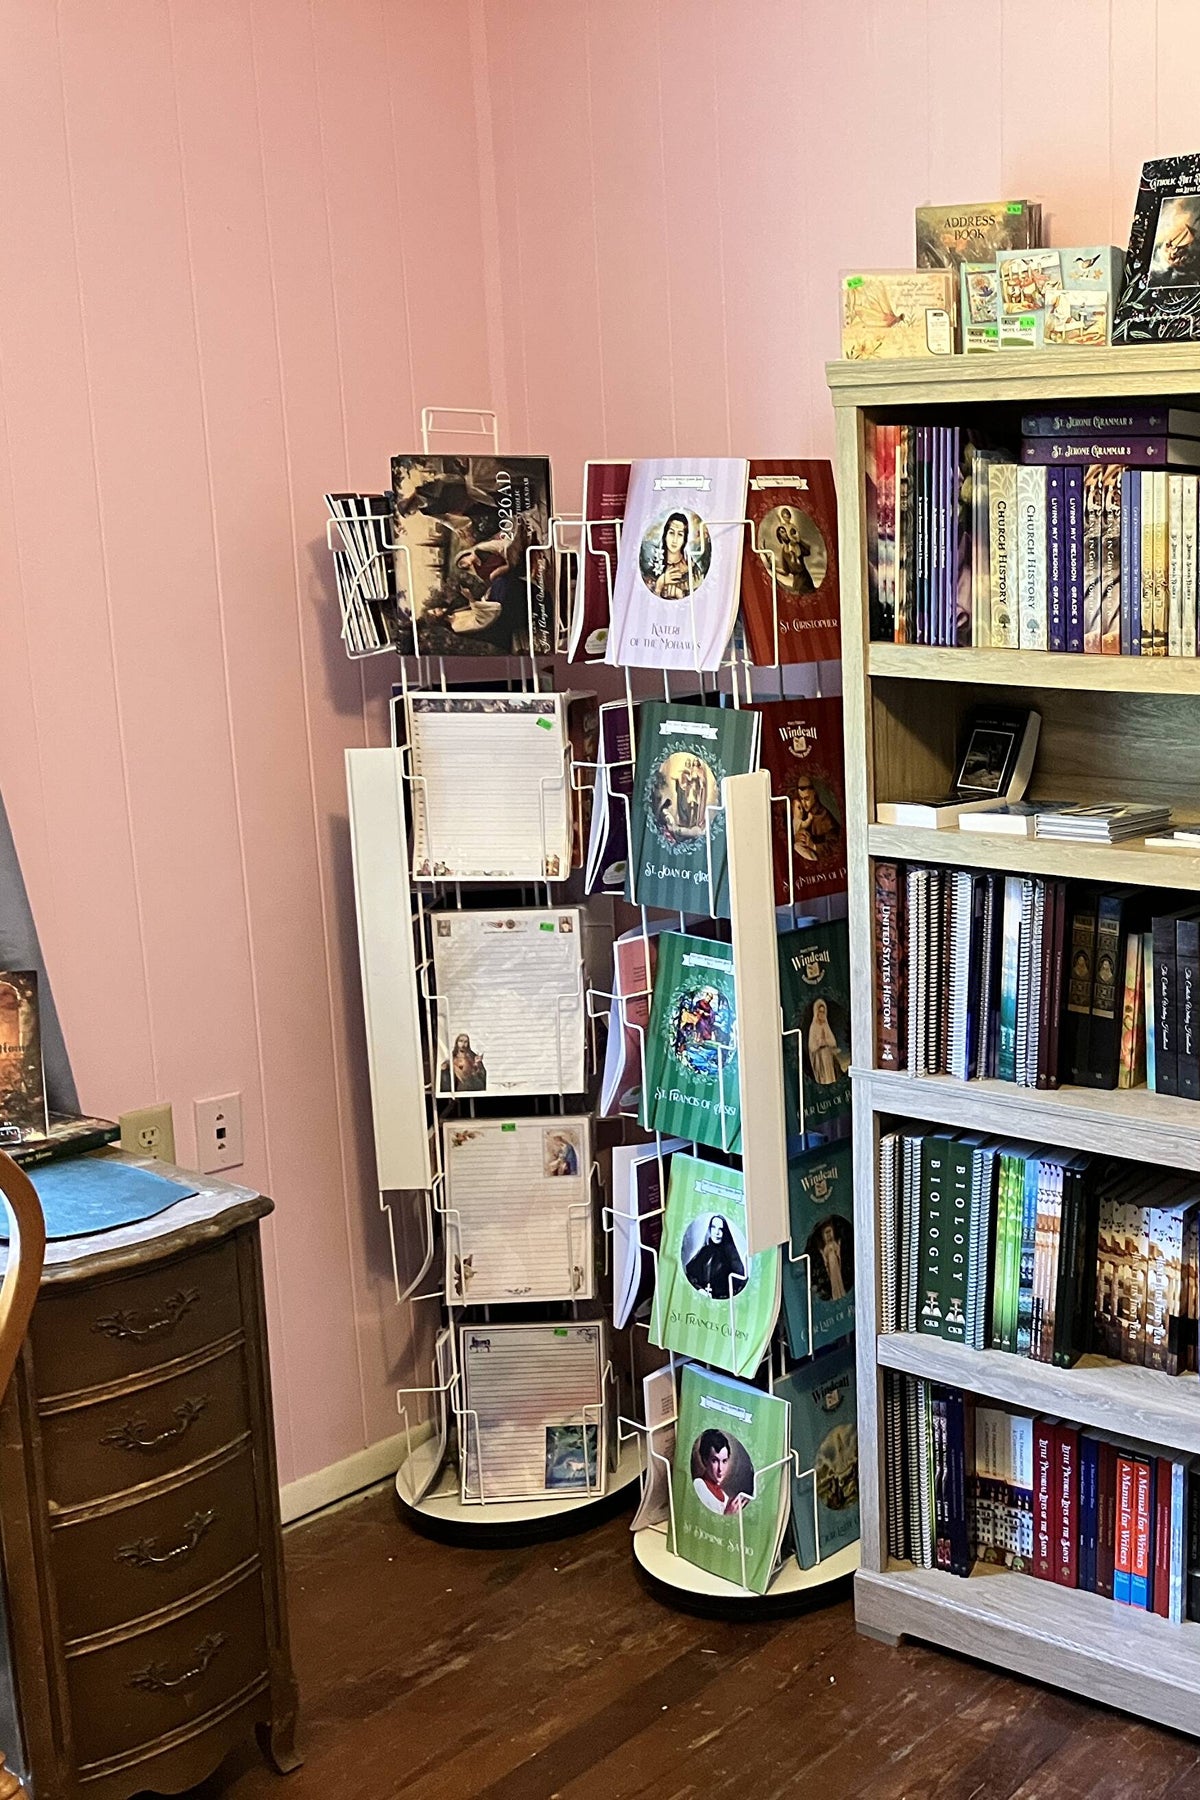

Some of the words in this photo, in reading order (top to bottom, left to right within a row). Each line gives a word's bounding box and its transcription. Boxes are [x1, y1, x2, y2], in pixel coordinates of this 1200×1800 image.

[1150, 178, 1176, 190] CATHOLIC
[1178, 174, 1193, 187] ART
[944, 215, 996, 228] ADDRESS
[954, 229, 986, 241] BOOK
[1064, 445, 1090, 458] JEROME
[1091, 445, 1126, 458] GRAMMAR
[1126, 447, 1131, 455] 8
[998, 501, 1007, 550] CHURCH
[1027, 505, 1036, 555] CHURCH
[1052, 527, 1058, 540] MY
[1071, 527, 1077, 540] MY
[998, 555, 1008, 605] HISTORY
[1027, 559, 1036, 609] HISTORY
[651, 623, 680, 636] KATERI
[793, 618, 839, 632] CHRISTOPHER
[630, 638, 640, 647] OF
[643, 638, 656, 648] THE
[658, 864, 681, 879] JOAN
[681, 869, 692, 879] OF
[882, 906, 891, 946] UNITED
[882, 947, 891, 983] STATES
[883, 985, 892, 1030] HISTORY
[669, 1089, 700, 1107] FRANCIS
[701, 1099, 711, 1109] OF
[929, 1160, 941, 1275] BIOLOGY
[952, 1165, 966, 1281] BIOLOGY
[685, 1313, 720, 1331] FRANCES
[1138, 1467, 1147, 1475] A
[1138, 1477, 1148, 1514] Manual
[1137, 1515, 1147, 1531] for
[1137, 1533, 1147, 1569] Writers
